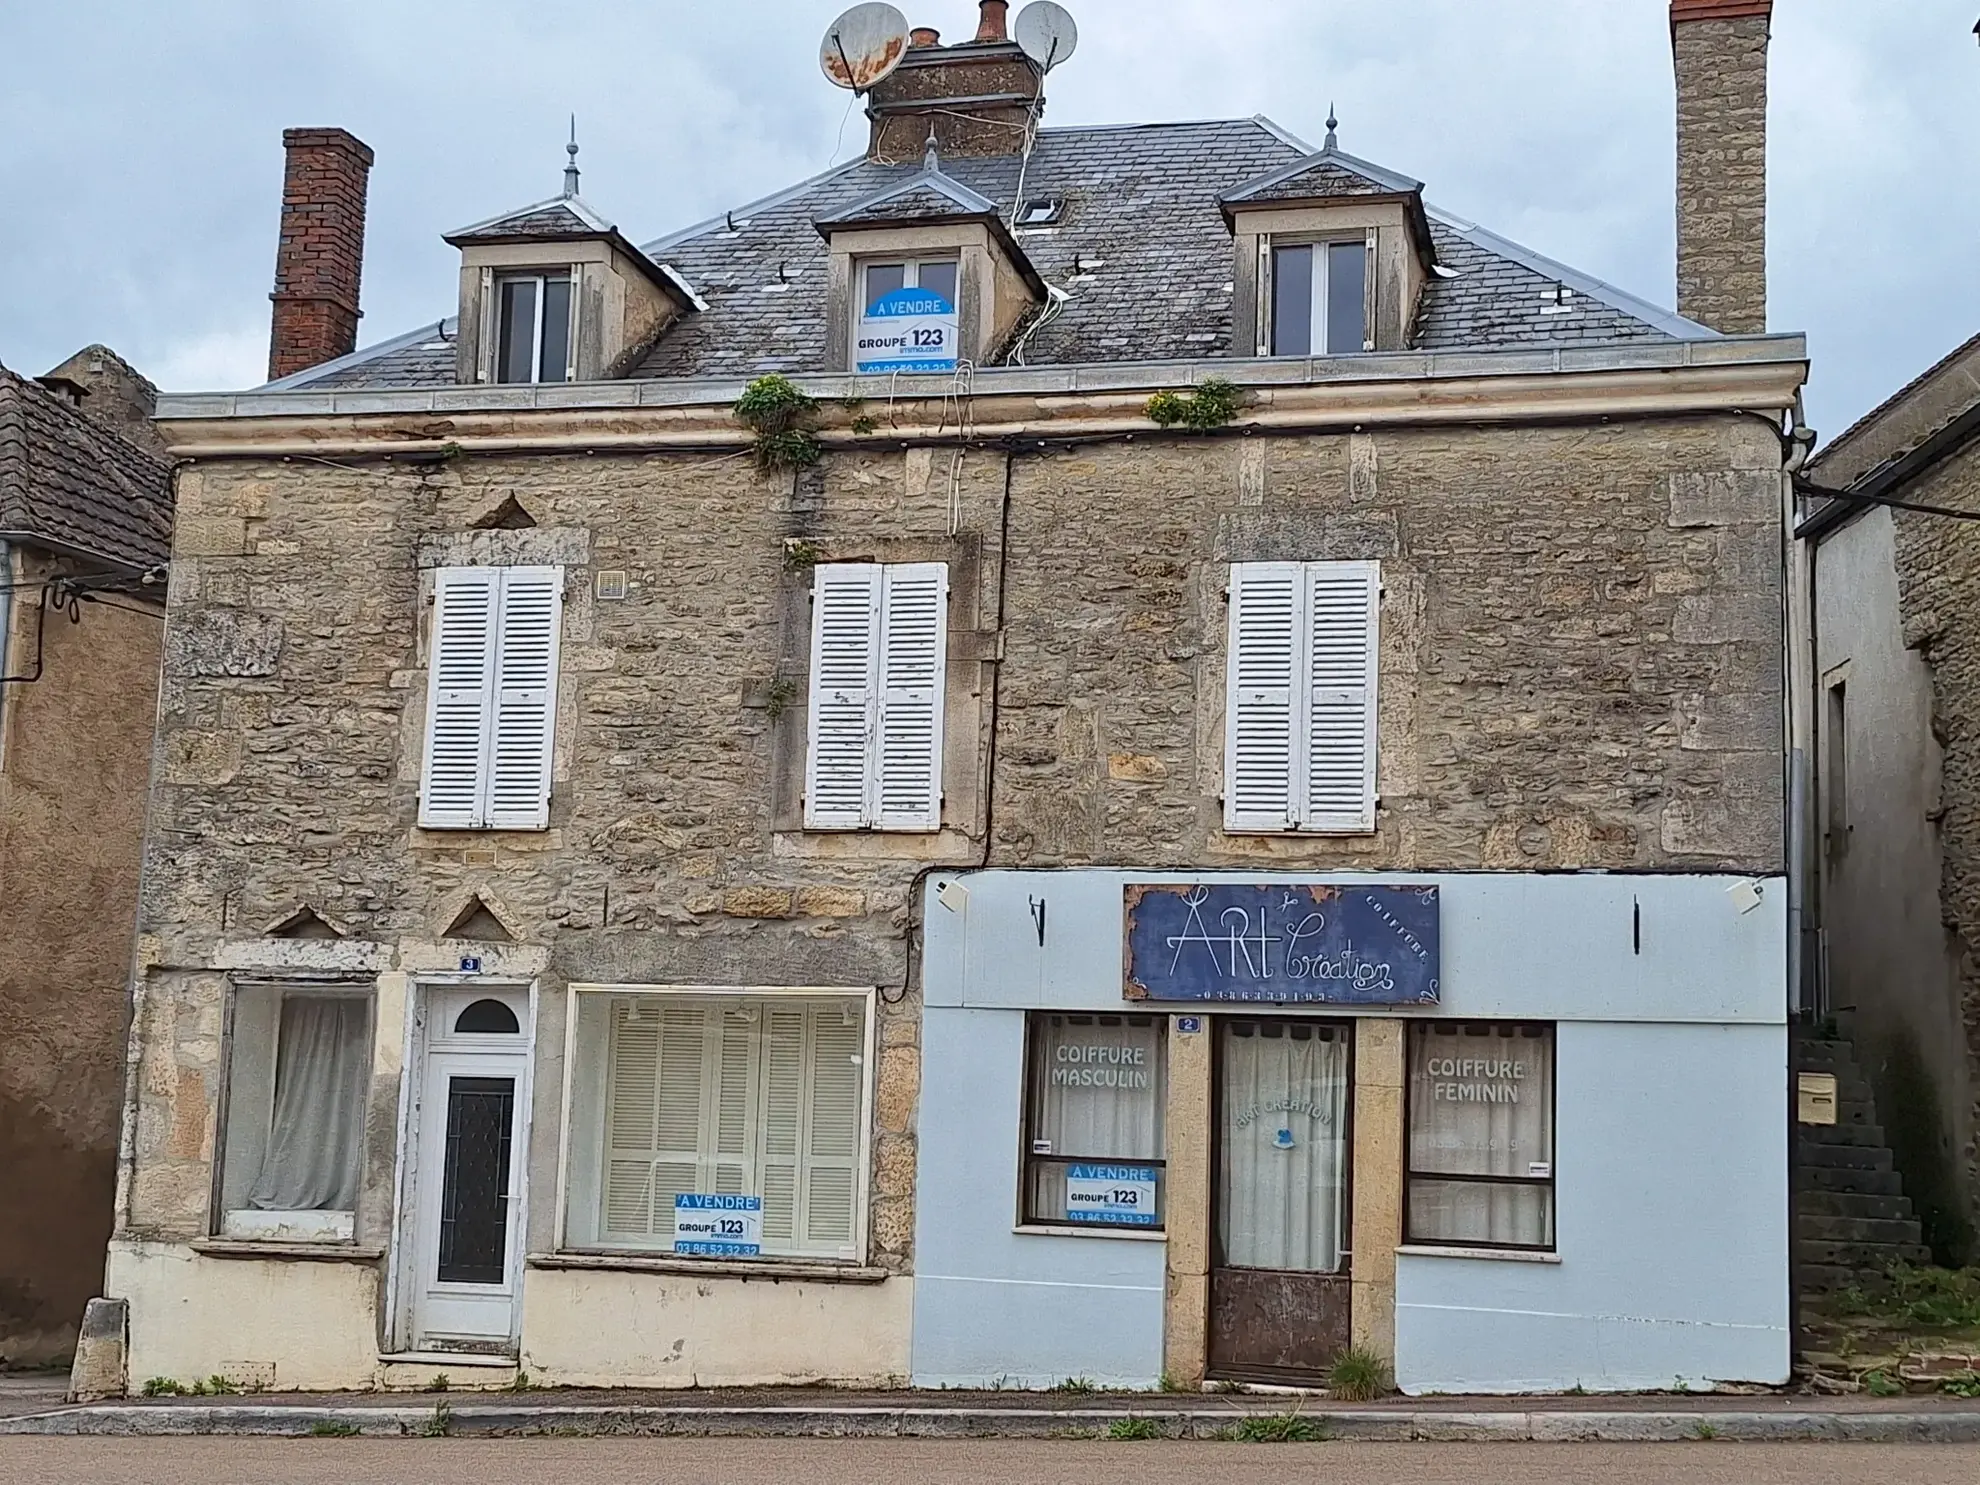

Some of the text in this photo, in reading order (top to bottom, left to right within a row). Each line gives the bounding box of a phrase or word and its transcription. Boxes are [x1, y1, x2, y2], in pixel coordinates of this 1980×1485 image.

[878, 300, 941, 315] A VENDRE
[858, 329, 944, 348] GROUPE 123
[466, 959, 474, 969] 3
[1184, 1018, 1193, 1030] 2
[1056, 1045, 1144, 1065] COIFFURE
[1428, 1058, 1525, 1079] COIFFURE
[1052, 1068, 1147, 1088] MASCULIN
[1435, 1083, 1518, 1103] FEMININ
[1264, 1099, 1332, 1126] CREATION
[1073, 1166, 1149, 1180] A VENDRE
[680, 1195, 755, 1209] A VENDRE
[1071, 1190, 1138, 1204] GROUPE 123
[679, 1220, 744, 1234] GROUPE 123
[676, 1242, 757, 1257] 03 86 52 32 32
